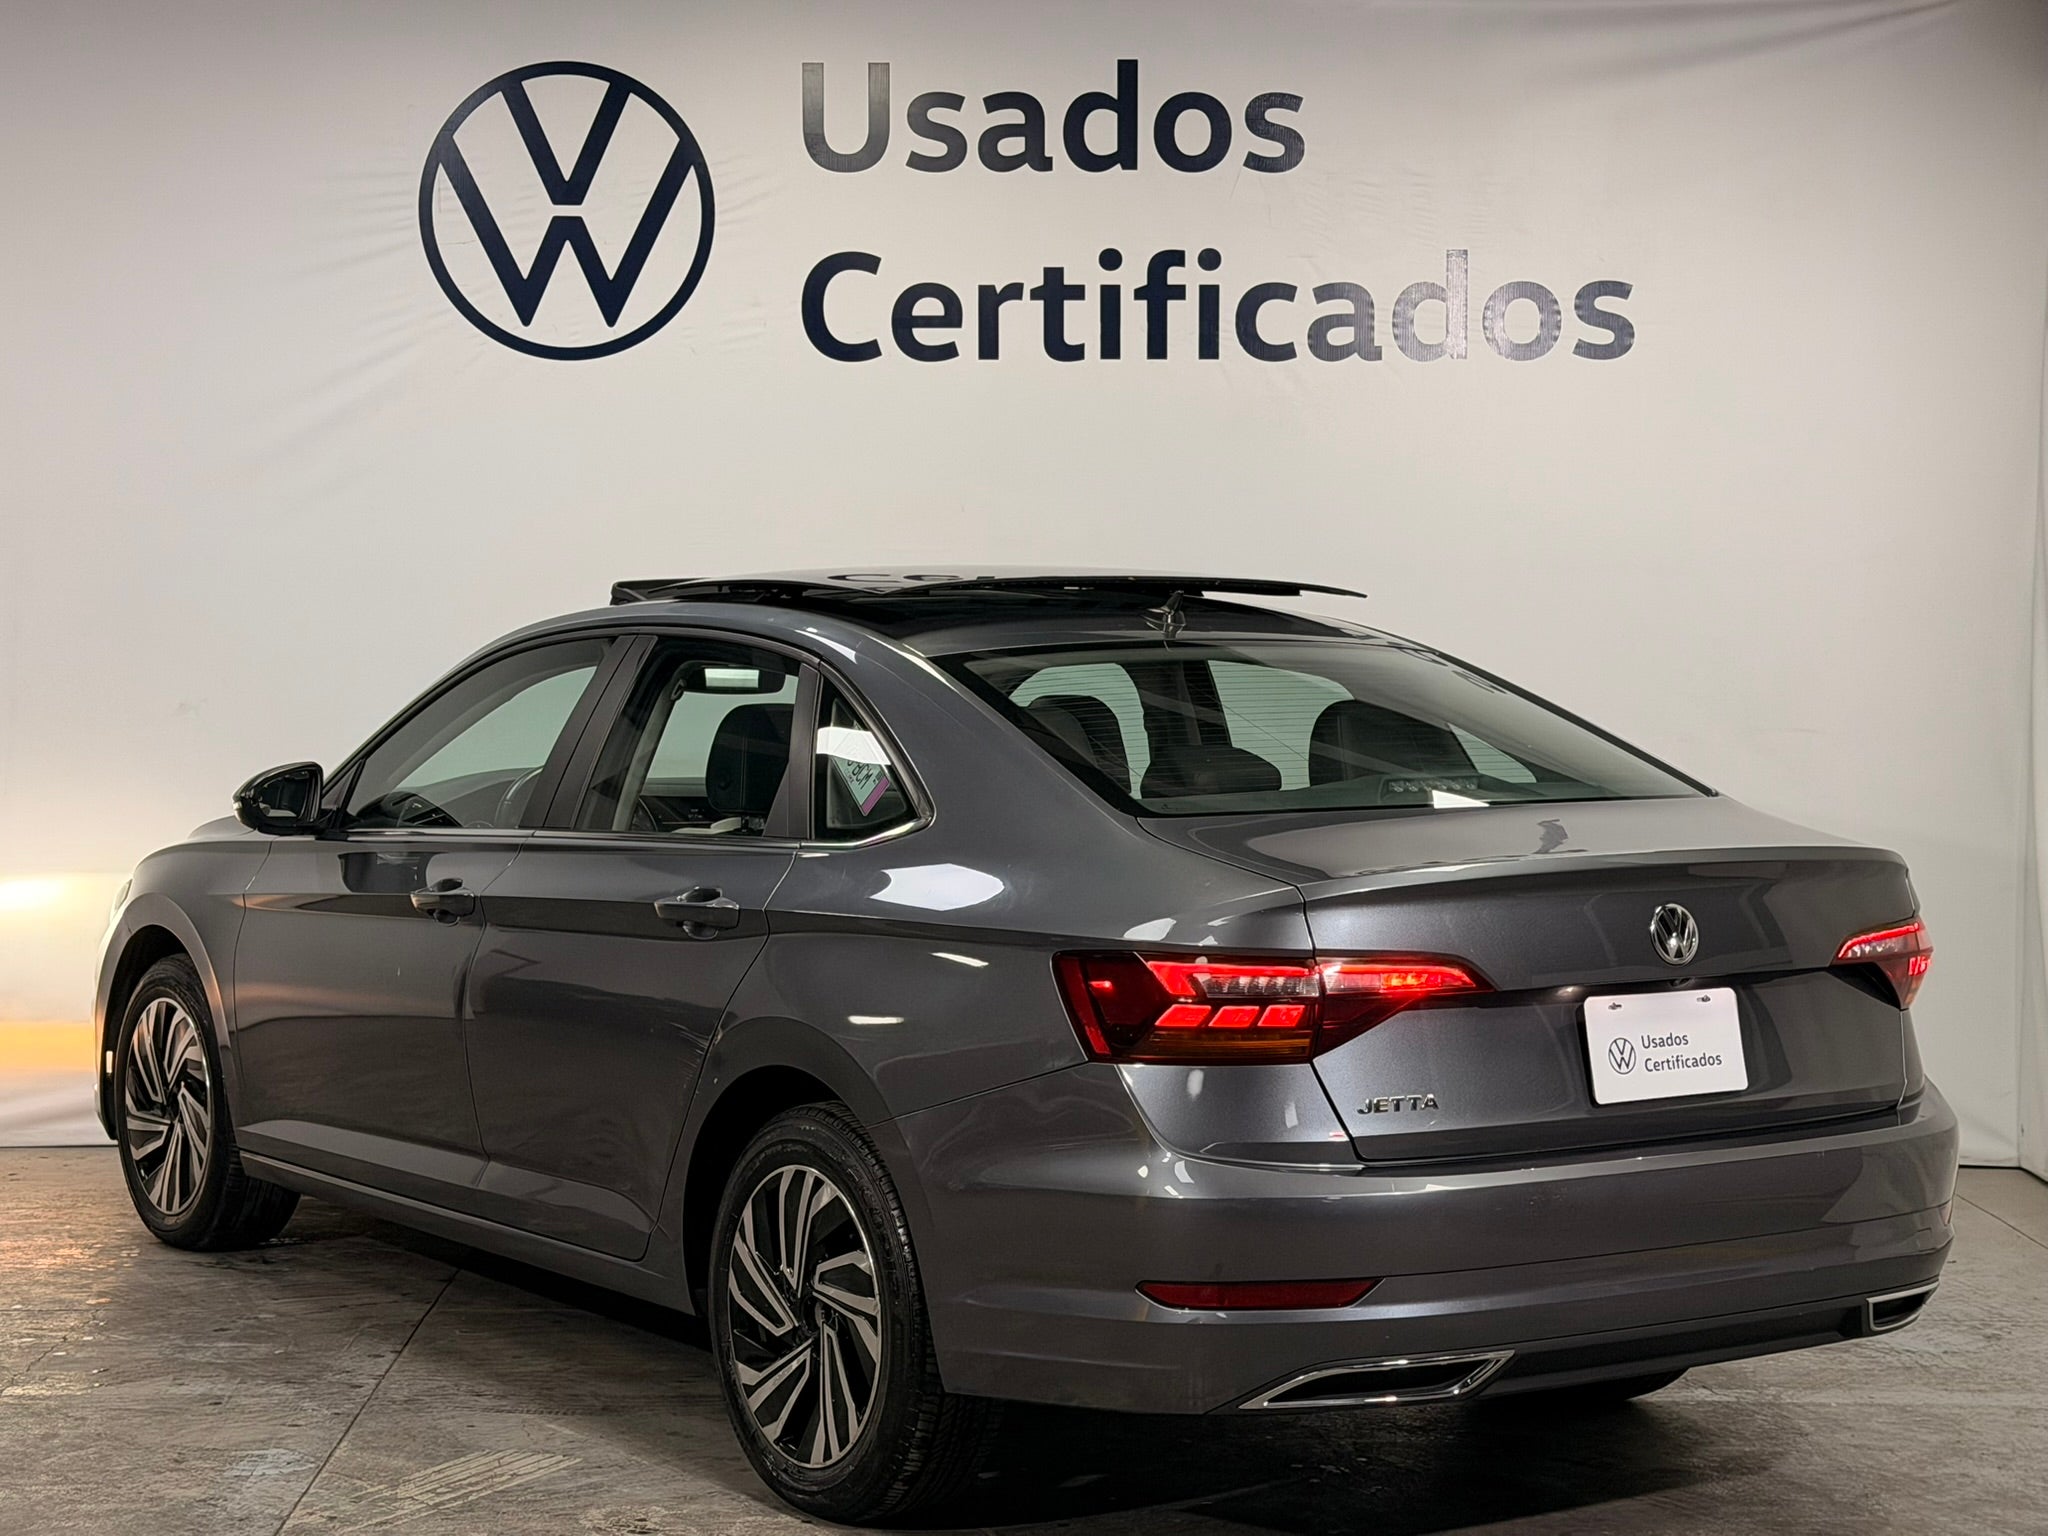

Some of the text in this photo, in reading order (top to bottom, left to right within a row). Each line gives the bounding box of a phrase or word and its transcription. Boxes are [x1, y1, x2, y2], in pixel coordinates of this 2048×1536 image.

[801, 59, 1306, 174] Usados
[801, 248, 1636, 363] Certificados
[1641, 1032, 1689, 1050] Usados
[1644, 1052, 1723, 1073] Certificados
[1357, 1093, 1439, 1115] JETTA
